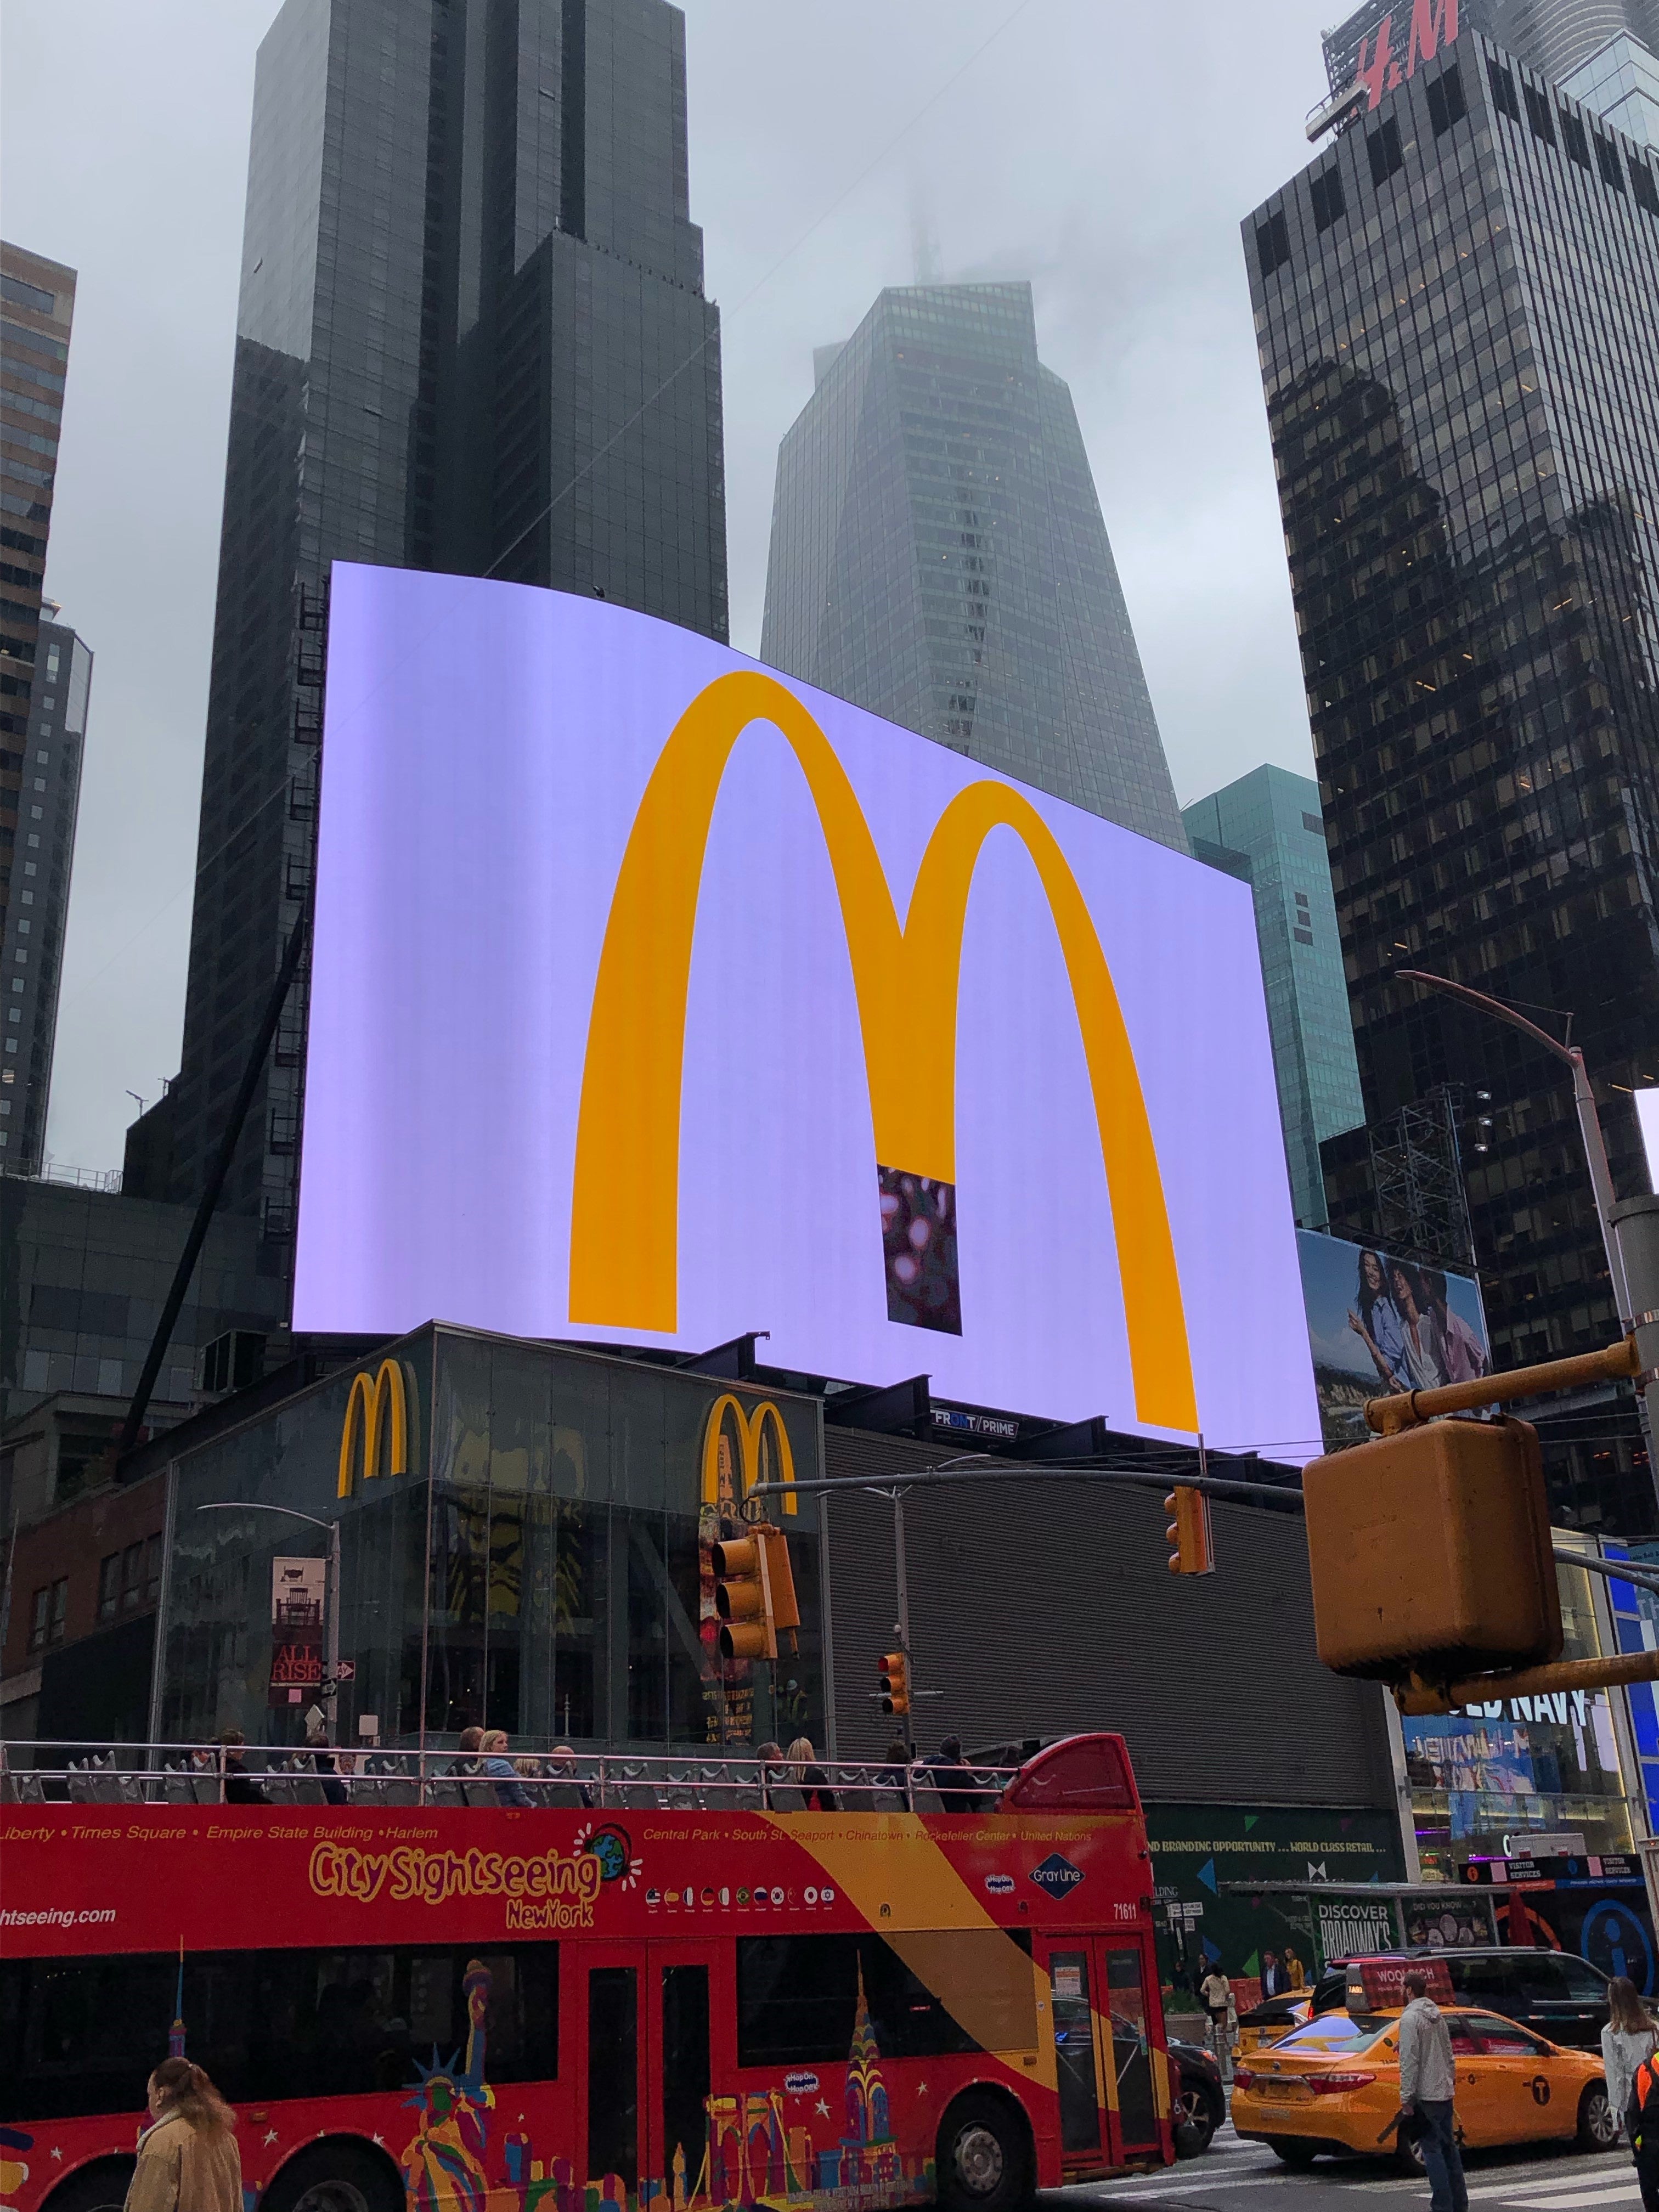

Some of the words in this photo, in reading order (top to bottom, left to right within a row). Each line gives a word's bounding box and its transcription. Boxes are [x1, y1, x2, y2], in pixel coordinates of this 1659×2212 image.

[983, 1420, 1014, 1436] PRIME
[276, 1645, 317, 1663] ALL
[272, 1662, 323, 1680] RISE
[72, 1826, 121, 1839] Times
[127, 1825, 186, 1841] Square
[207, 1826, 263, 1841] Empire
[268, 1826, 308, 1838] State
[313, 1826, 373, 1841] Building
[386, 1826, 438, 1838] Harlem
[643, 1829, 689, 1839] Central
[692, 1829, 720, 1840] Park
[732, 1829, 766, 1840] South
[790, 1830, 834, 1842] Seaport
[846, 1830, 904, 1841] Chinatown
[916, 1830, 972, 1841] Rockefeller
[977, 1830, 1009, 1841] Center
[1021, 1831, 1052, 1841] United
[1056, 1831, 1092, 1841] Nations
[1162, 1841, 1211, 1852] BRANDING
[1213, 1842, 1276, 1853] OPPORTUNITY
[1290, 1842, 1319, 1853] WORLD
[1321, 1842, 1345, 1853] CLASS
[1346, 1843, 1374, 1853] RETAIL
[1510, 1870, 1541, 1879] SERVICES
[0, 1908, 116, 1928] htseeing.com
[1114, 1903, 1137, 1920] 71611
[1319, 1905, 1387, 1920] DISCOVER
[1321, 1921, 1392, 1959] BROADWAY'S
